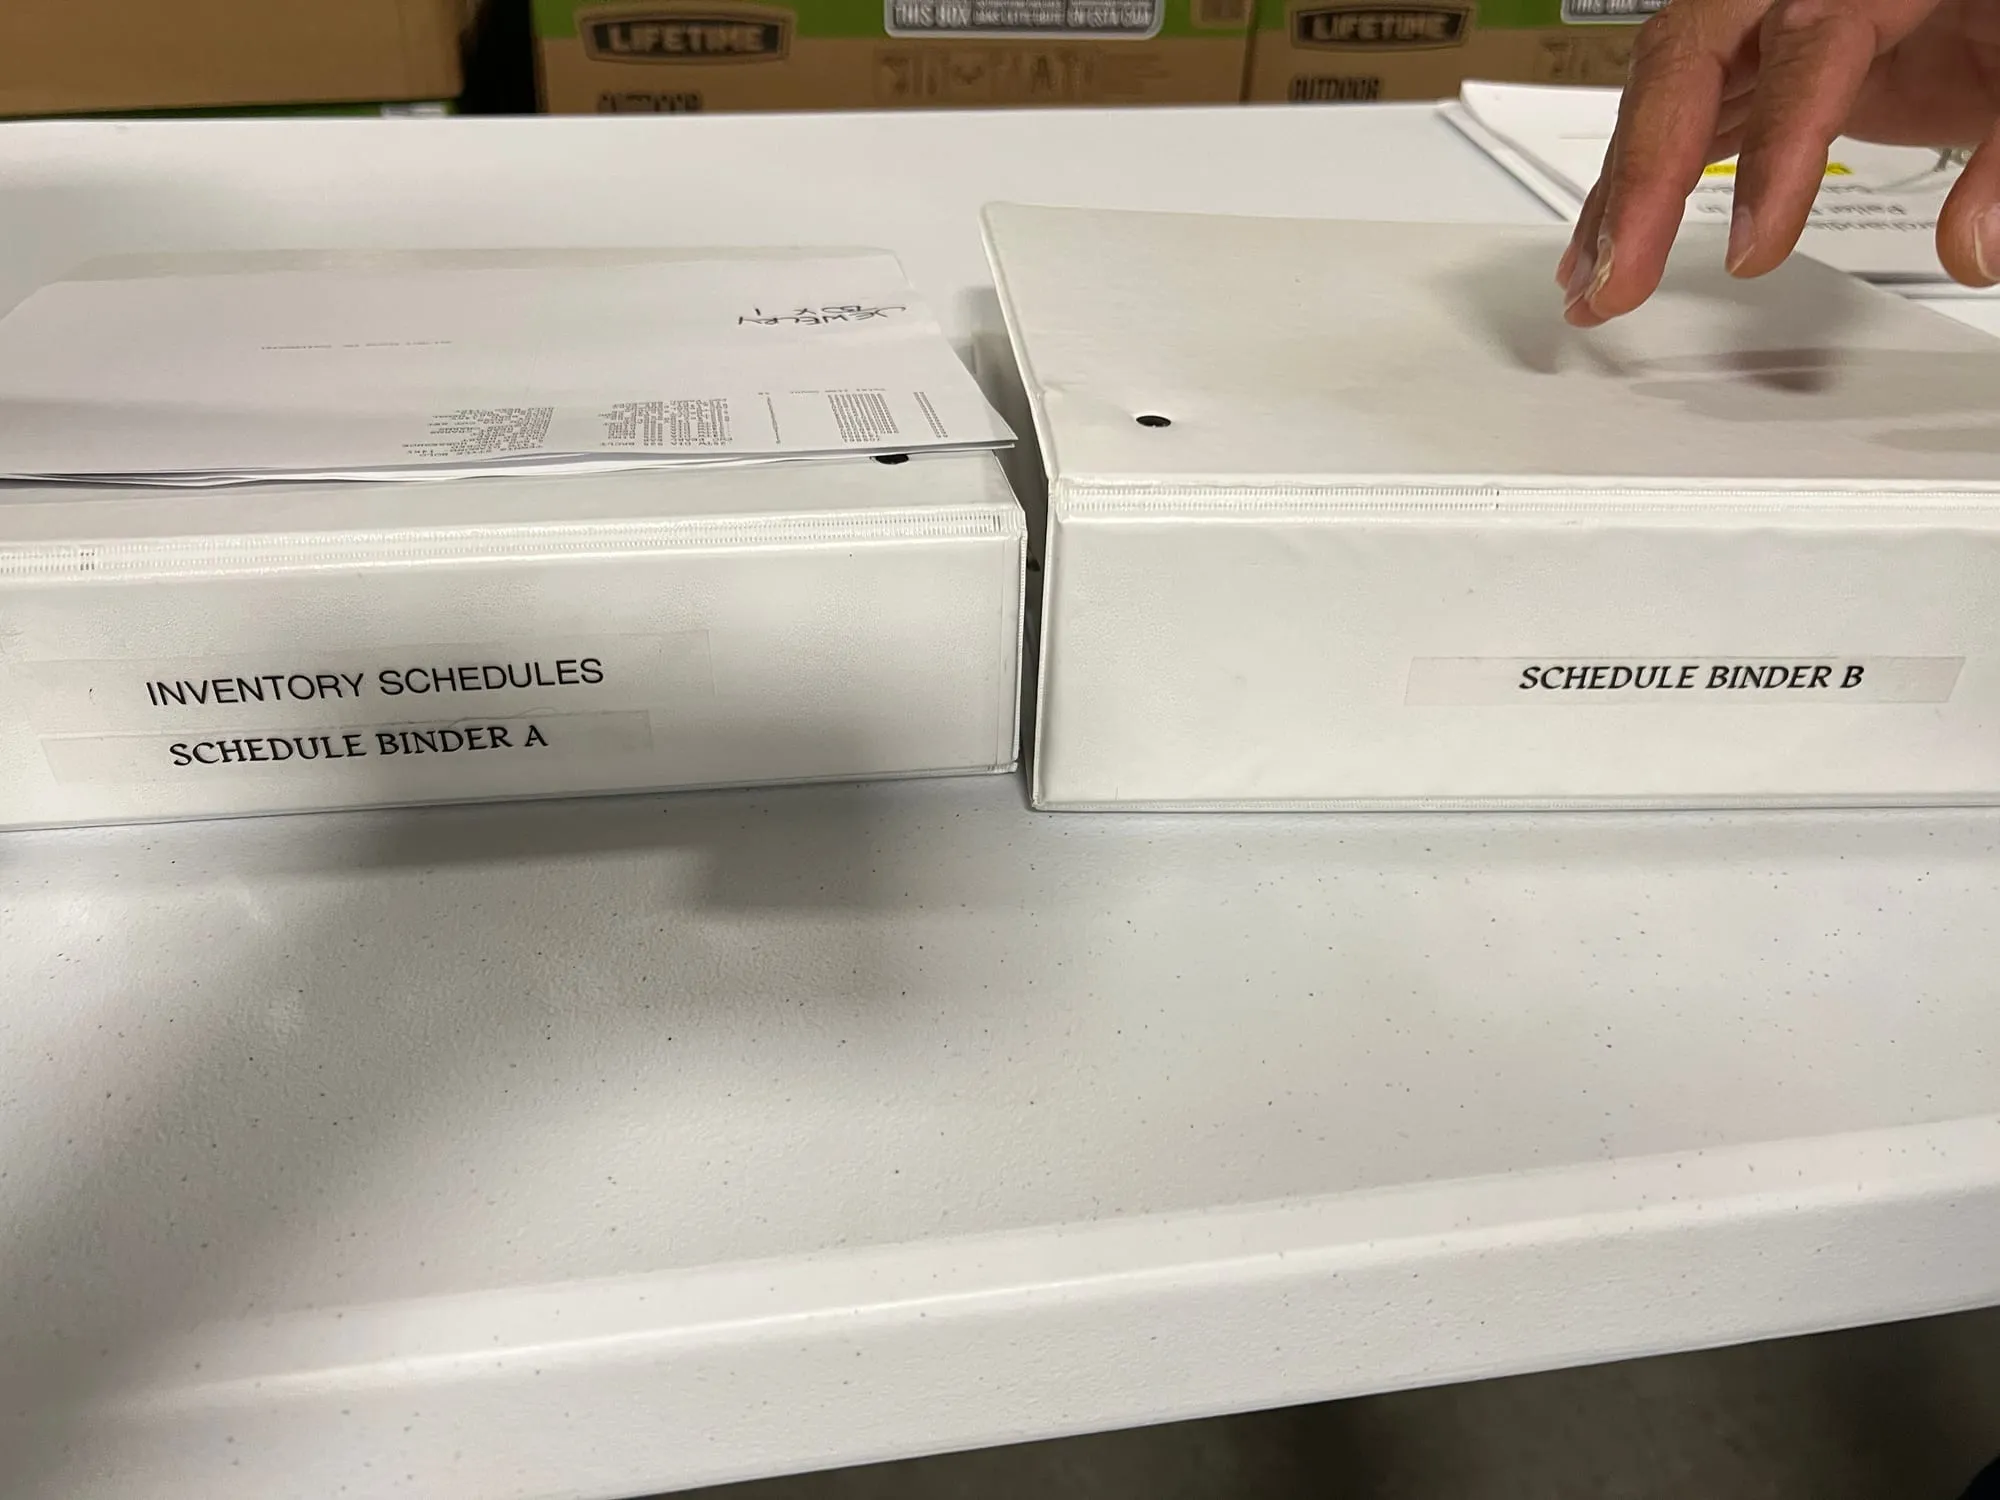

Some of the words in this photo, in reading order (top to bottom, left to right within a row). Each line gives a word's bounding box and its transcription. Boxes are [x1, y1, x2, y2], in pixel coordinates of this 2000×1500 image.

[607, 23, 764, 52] LIFETIME
[1312, 11, 1449, 41] LIFETIME
[146, 672, 365, 706] INVENTORY
[378, 657, 604, 696] SCHEDULES
[1519, 665, 1699, 690] SCHEDULE
[1705, 665, 1833, 689] BINDER
[1839, 665, 1865, 689] B
[169, 733, 368, 766] SCHEDULE
[374, 724, 515, 756] BINDER
[522, 723, 550, 748] A
